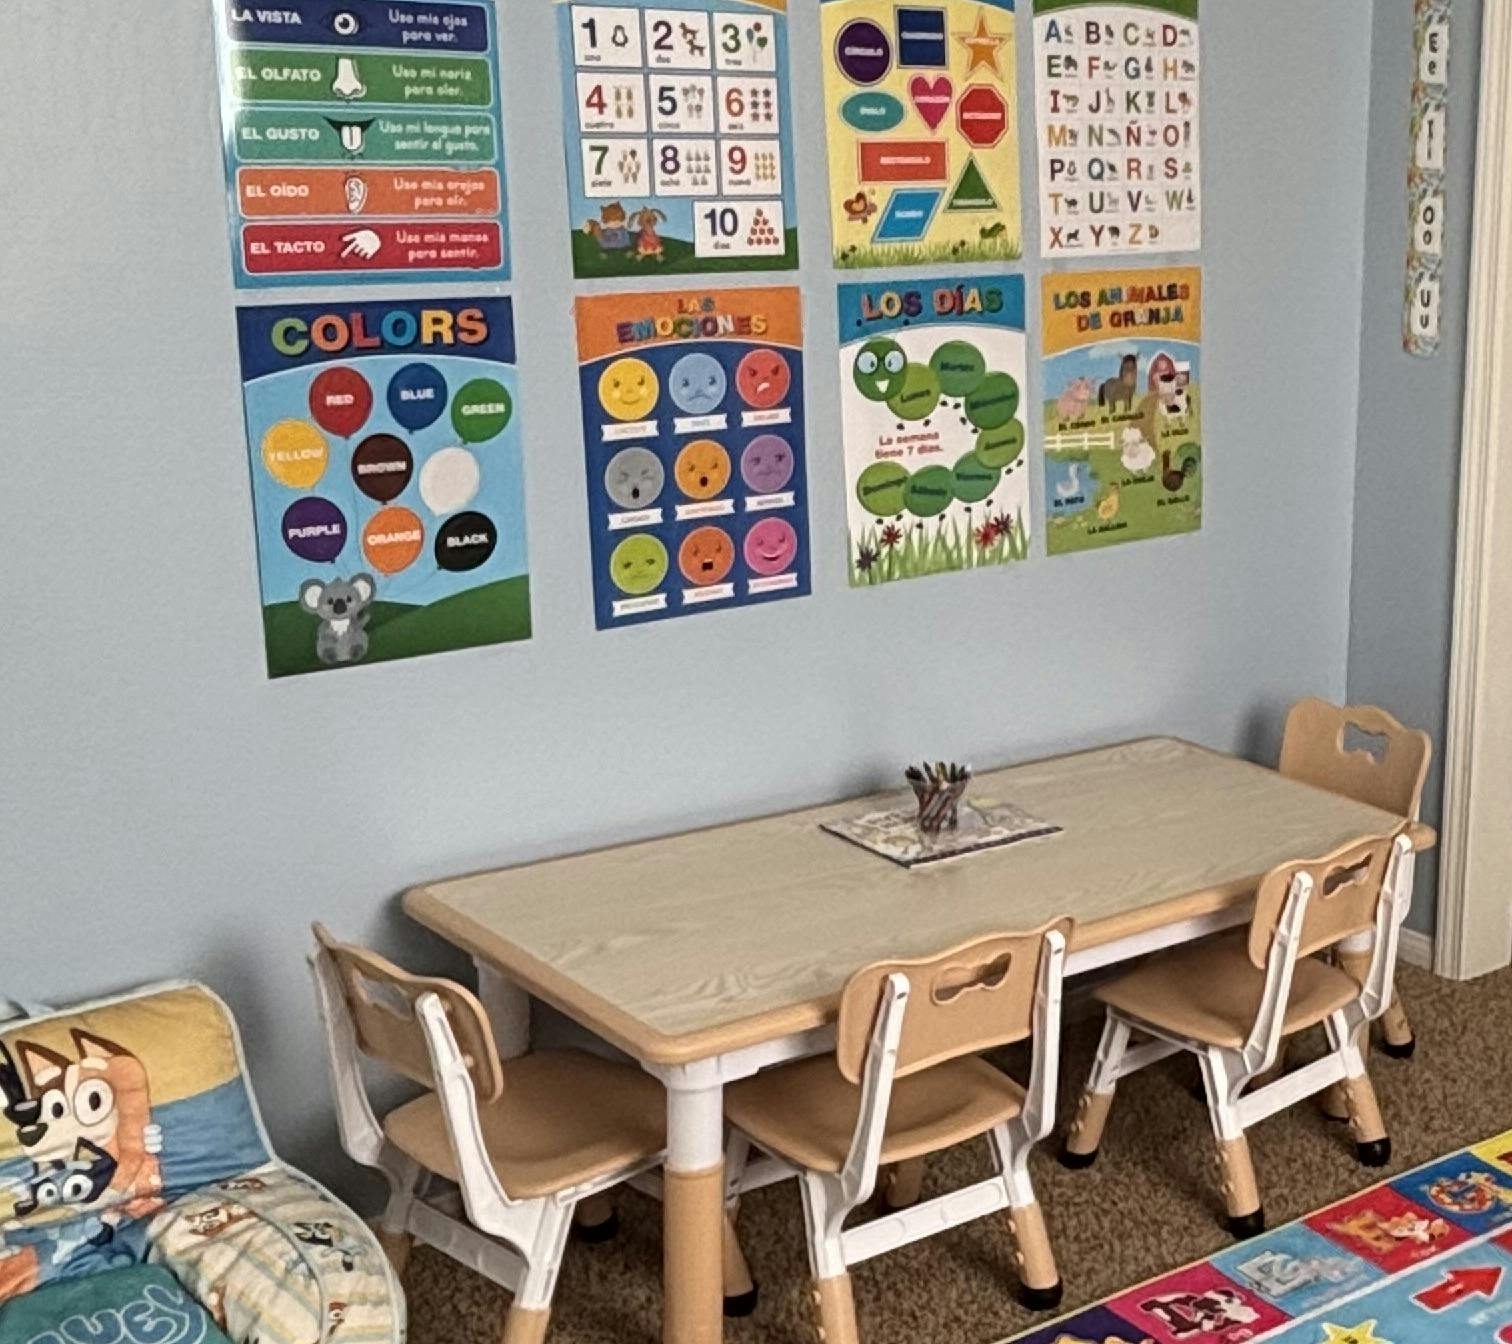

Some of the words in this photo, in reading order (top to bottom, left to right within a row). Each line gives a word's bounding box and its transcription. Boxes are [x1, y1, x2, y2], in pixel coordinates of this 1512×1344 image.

[231, 9, 253, 22] LA
[257, 10, 302, 25] VISTA
[581, 18, 597, 48] 1
[653, 21, 673, 50] 2
[722, 23, 741, 53] 3
[261, 68, 321, 81] OLFATO
[585, 84, 607, 115] 4
[658, 87, 678, 116] 5
[725, 88, 745, 117] 6
[242, 128, 262, 140] EL
[266, 128, 320, 141] GUSTO
[589, 145, 610, 176] 7
[660, 144, 680, 175] 8
[728, 145, 747, 176] 9
[245, 185, 266, 197] EL
[704, 208, 738, 236] 10
[250, 242, 271, 254] EL
[274, 241, 326, 253] TACTO
[677, 296, 715, 314] LAS
[862, 291, 923, 321] LOS
[932, 284, 1003, 316] DÍAS
[1053, 290, 1091, 310] LOS
[1097, 283, 1190, 307] ANIMALES
[617, 313, 768, 343] EMOCIONES
[1076, 312, 1102, 332] DE
[1109, 306, 1184, 328] GRANJA
[270, 307, 490, 356] COLORS
[325, 393, 355, 407] RED
[400, 387, 435, 402] BLUE
[460, 402, 506, 417] GREEN
[267, 446, 324, 464] YELLOW
[357, 460, 407, 477] BROWN
[287, 523, 342, 540] PURPLE
[366, 528, 422, 547] ORANGE
[446, 533, 489, 548] BLACK
